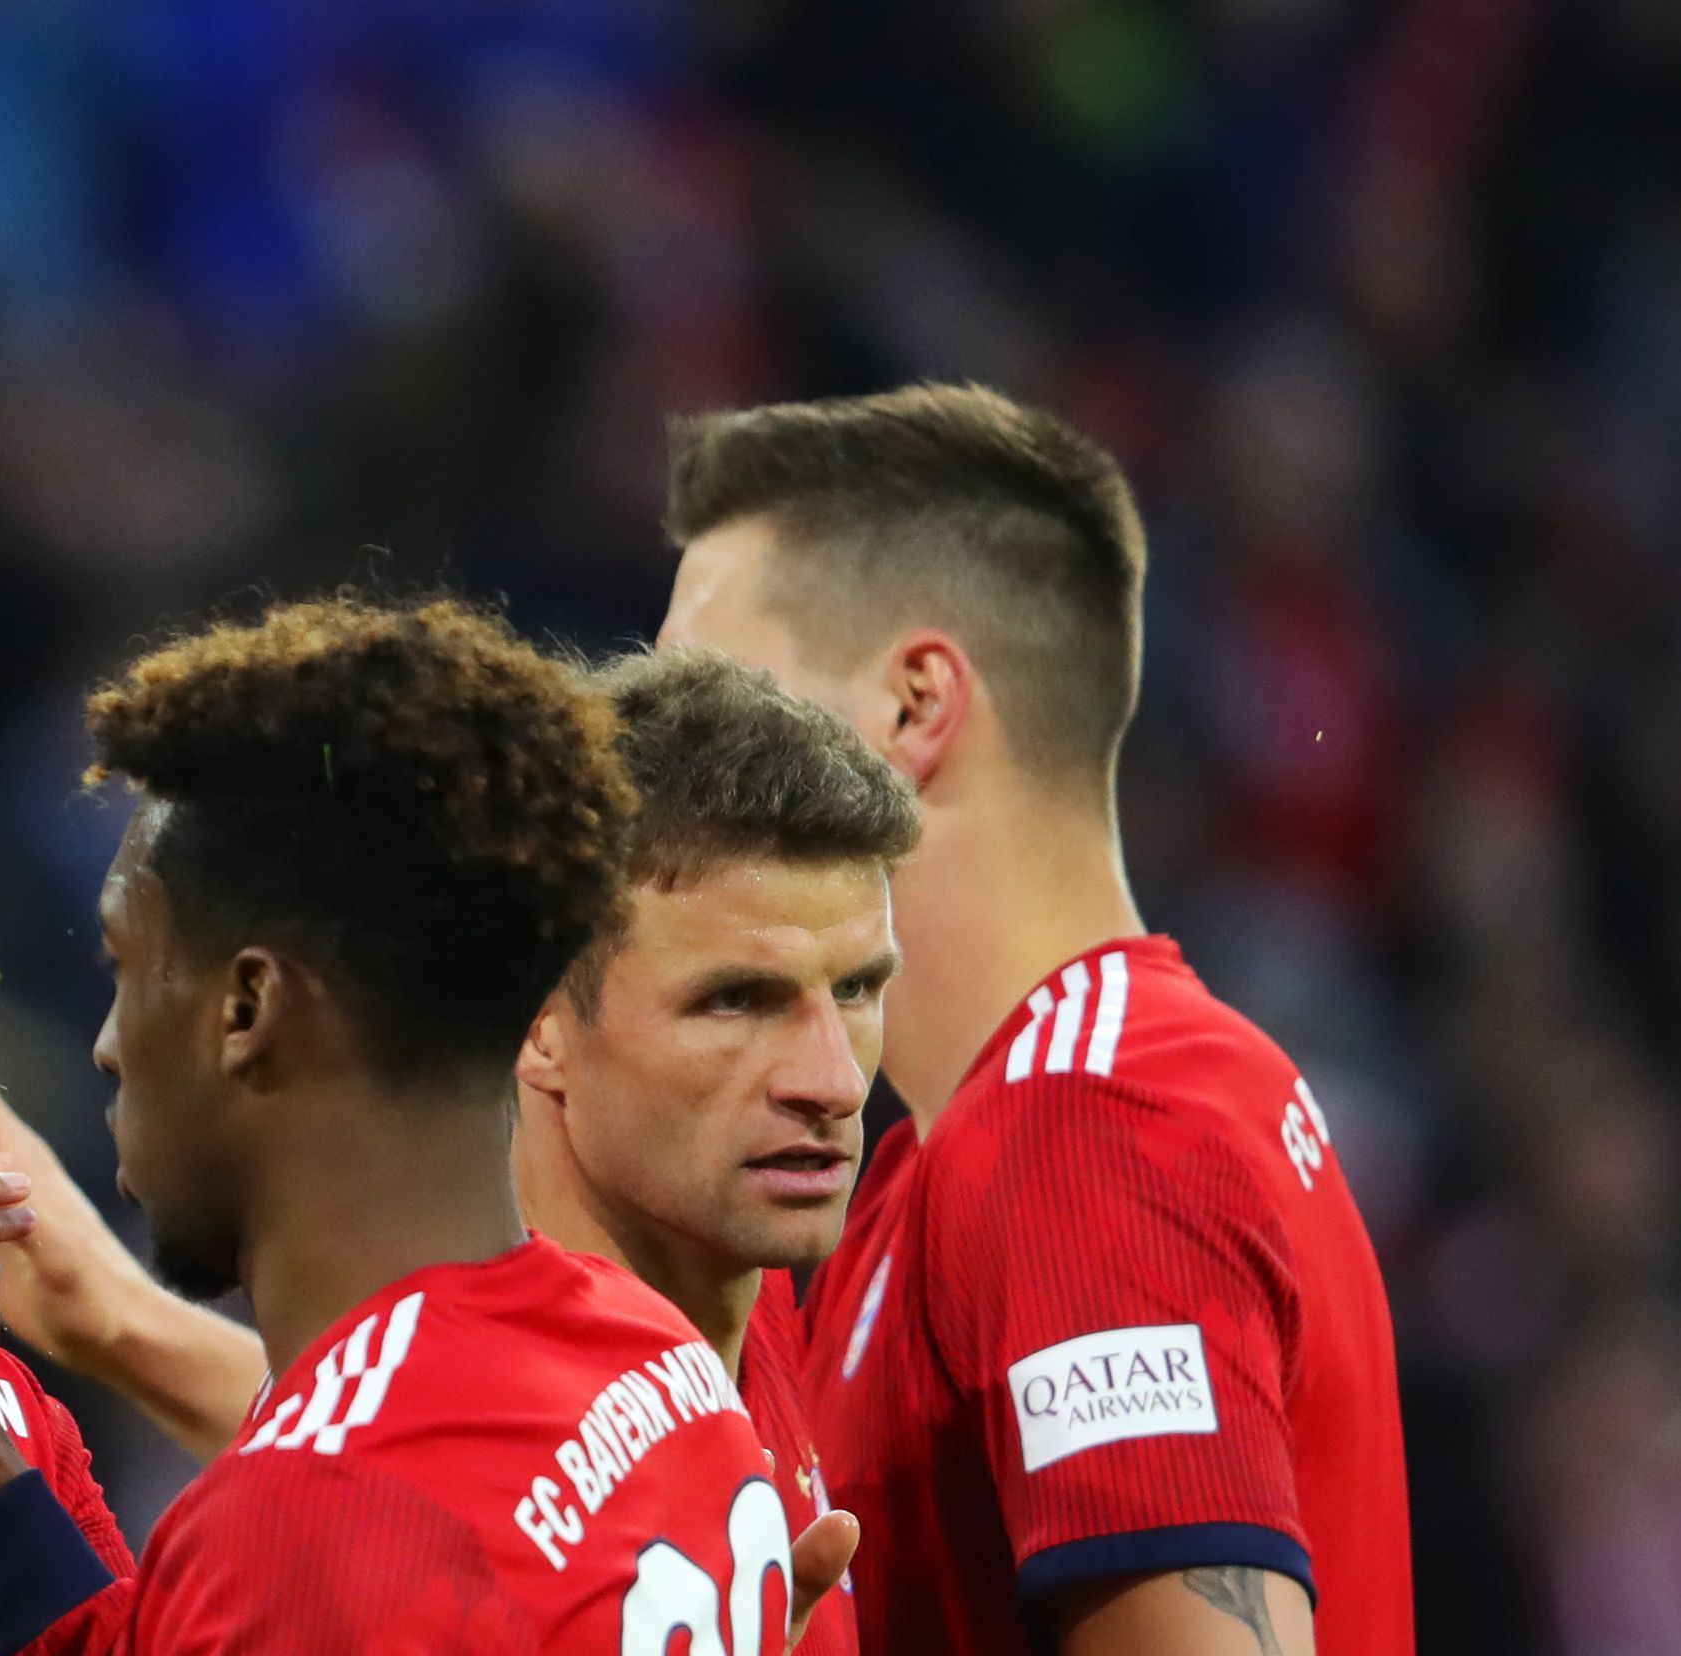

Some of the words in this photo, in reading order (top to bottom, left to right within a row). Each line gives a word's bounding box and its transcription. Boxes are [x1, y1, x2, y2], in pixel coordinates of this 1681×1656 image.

[1022, 1347, 1196, 1417] QATAR
[1067, 1387, 1203, 1430] AIRWAYS
[513, 1475, 584, 1572] FC
[554, 1369, 676, 1516] BAYERN
